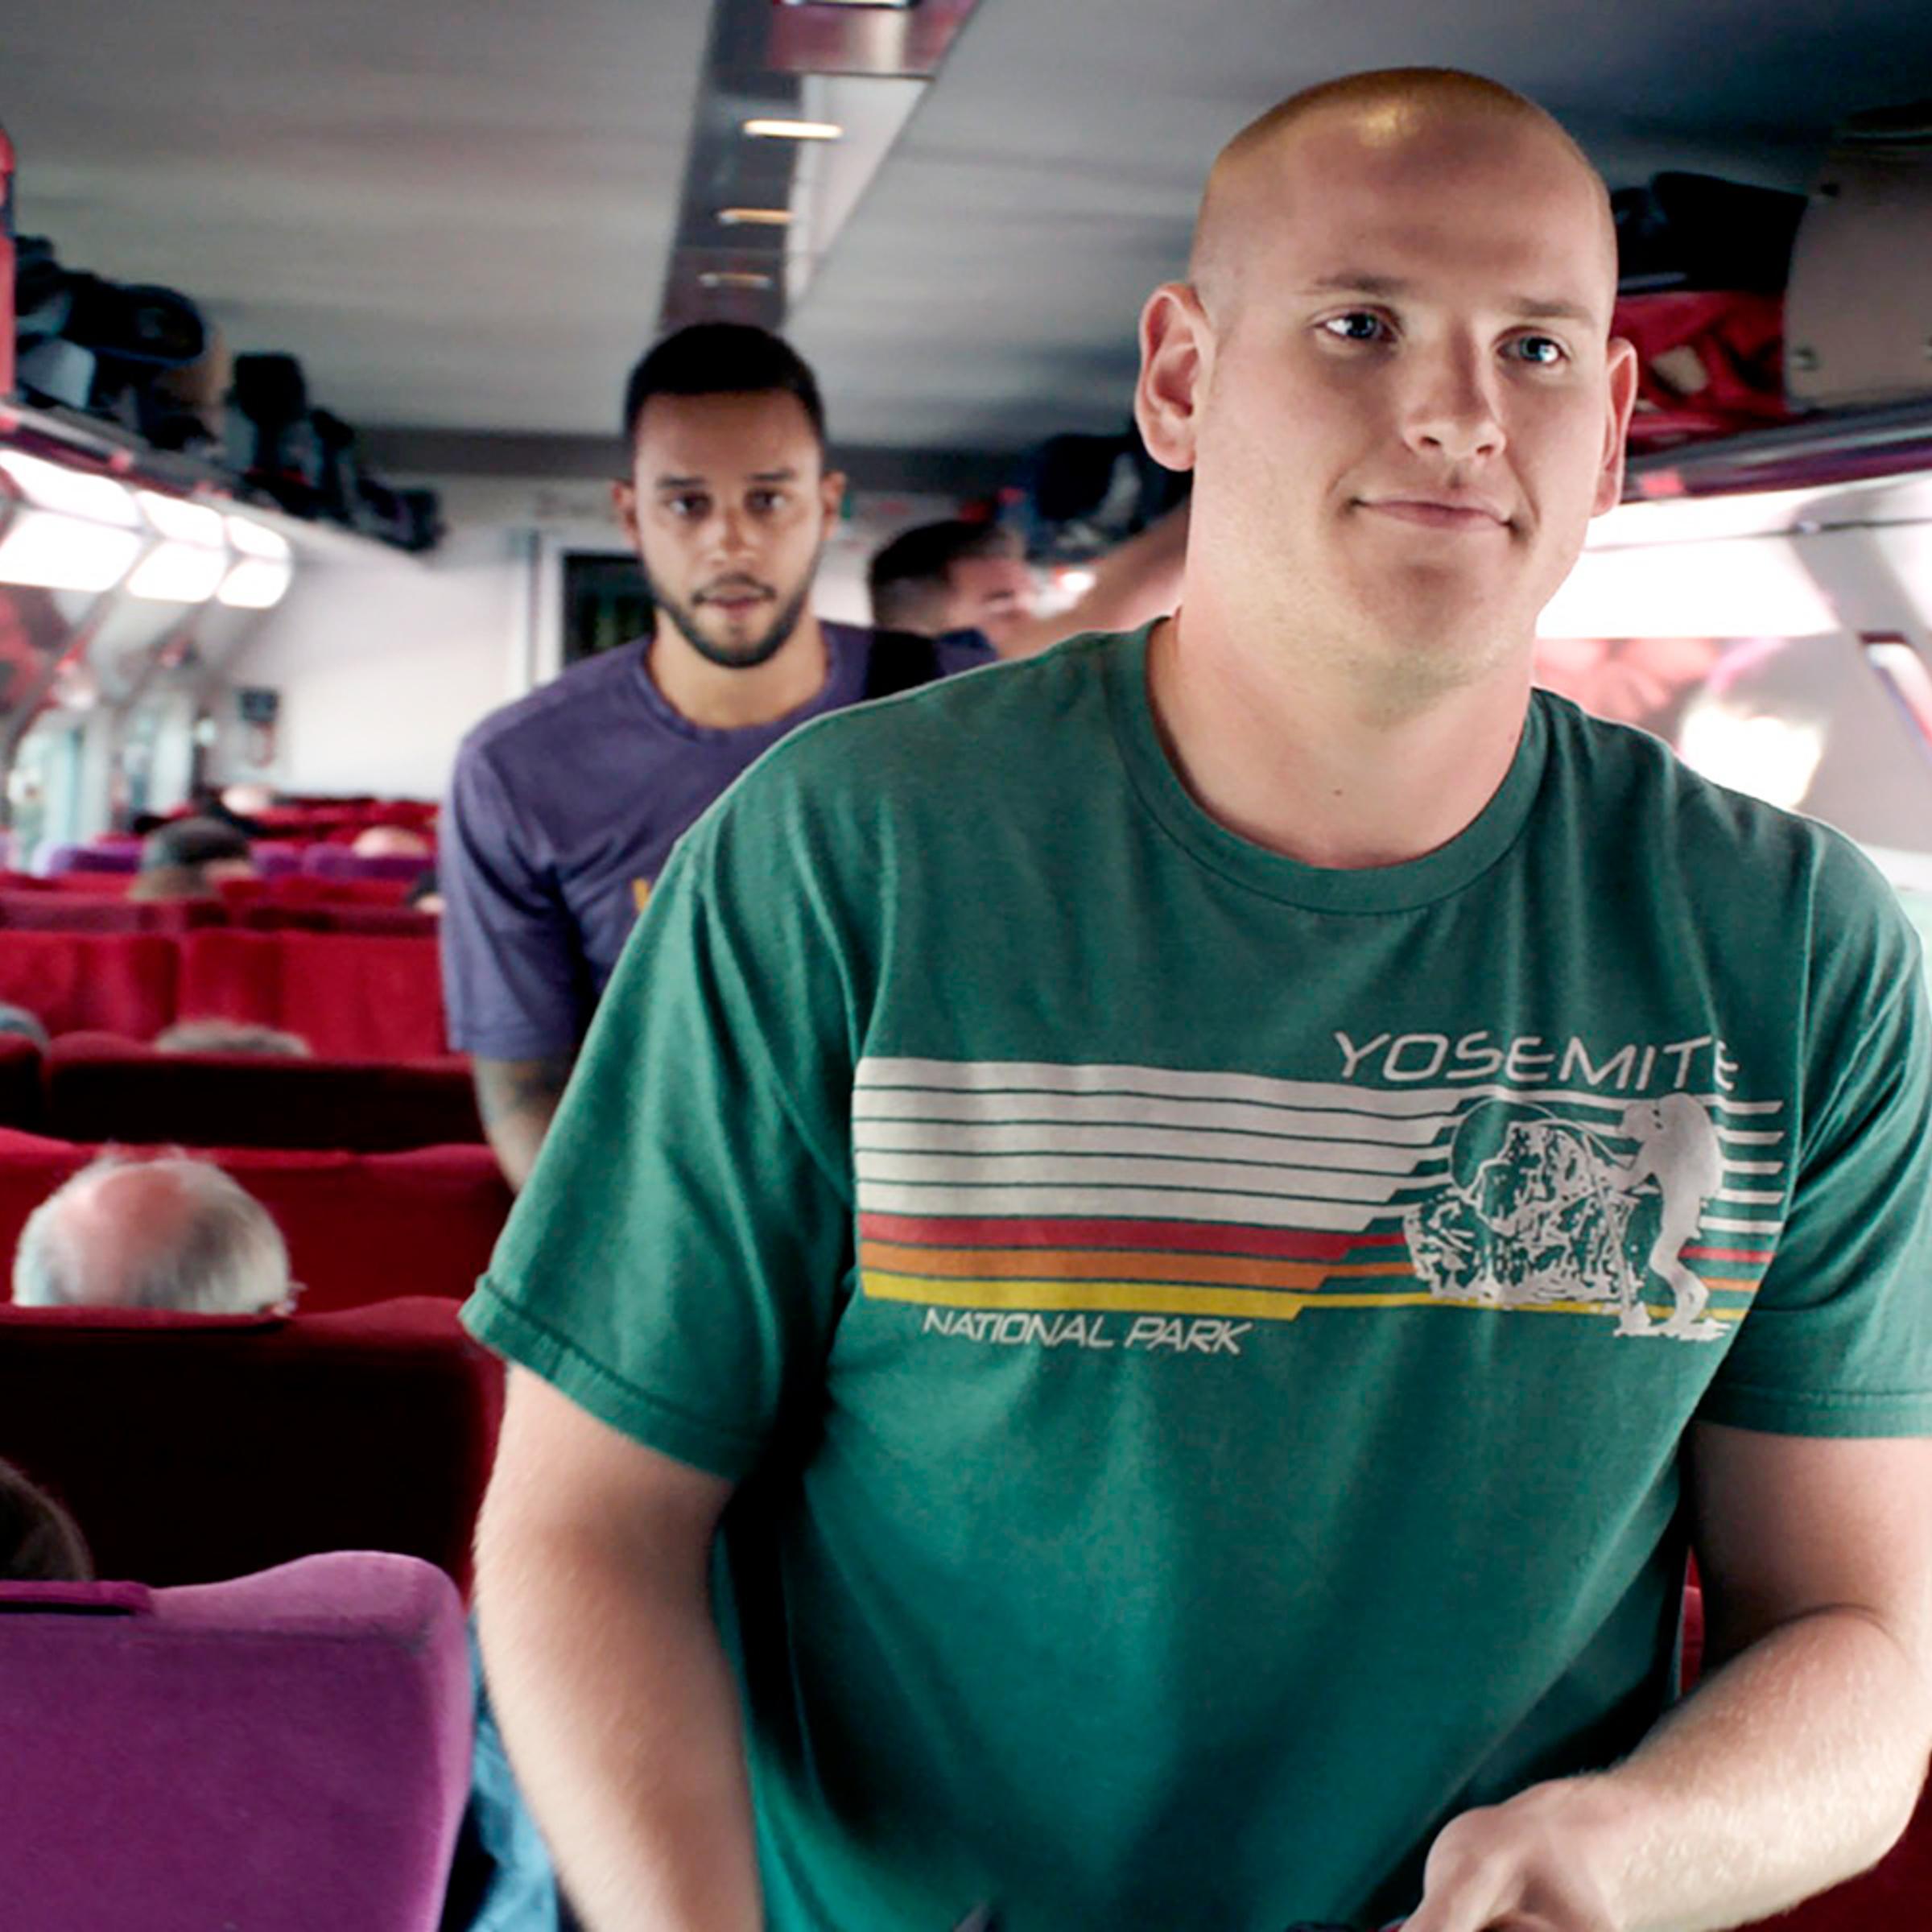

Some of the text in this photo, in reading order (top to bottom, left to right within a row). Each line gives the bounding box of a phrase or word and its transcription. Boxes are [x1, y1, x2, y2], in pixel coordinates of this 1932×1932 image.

[1335, 1031, 1739, 1091] YOSEMITE
[923, 1307, 1253, 1355] NATIONAL PARK
